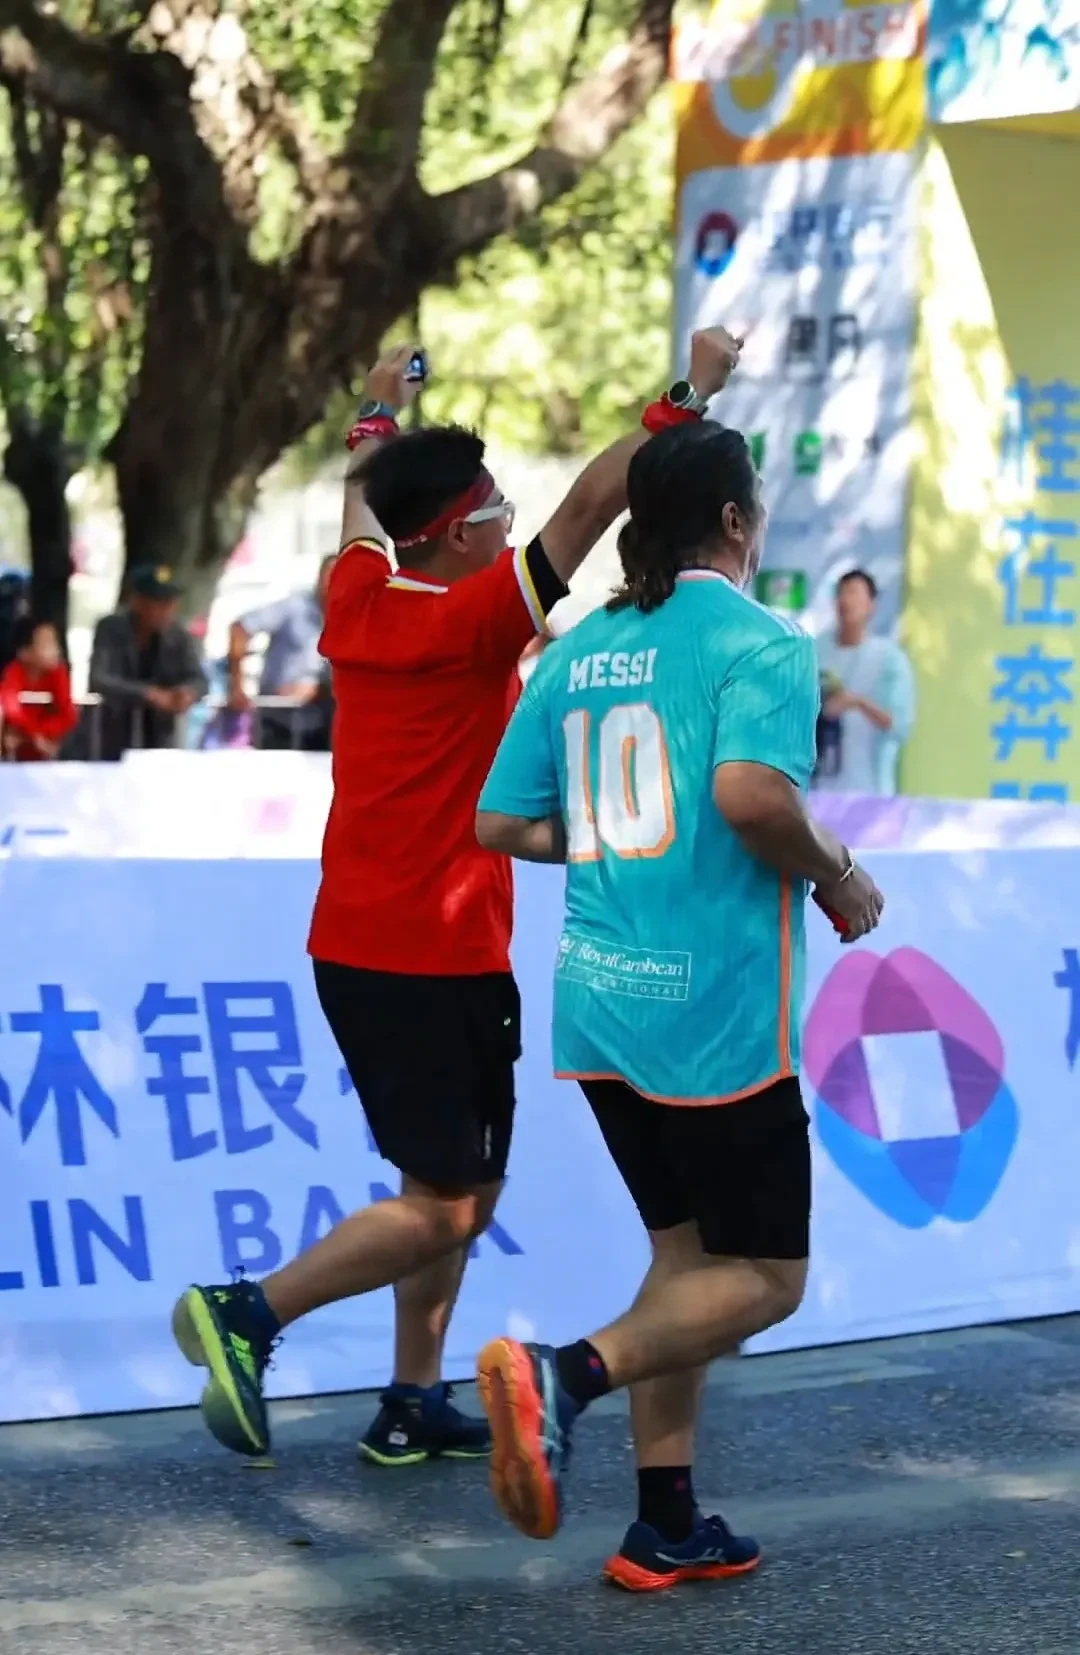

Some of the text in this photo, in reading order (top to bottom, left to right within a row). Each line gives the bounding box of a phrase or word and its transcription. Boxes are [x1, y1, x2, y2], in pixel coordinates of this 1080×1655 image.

[774, 8, 906, 56] FINISH
[989, 377, 1080, 803] 桂在奔
[567, 647, 658, 693] MESSI
[562, 702, 676, 863] 10
